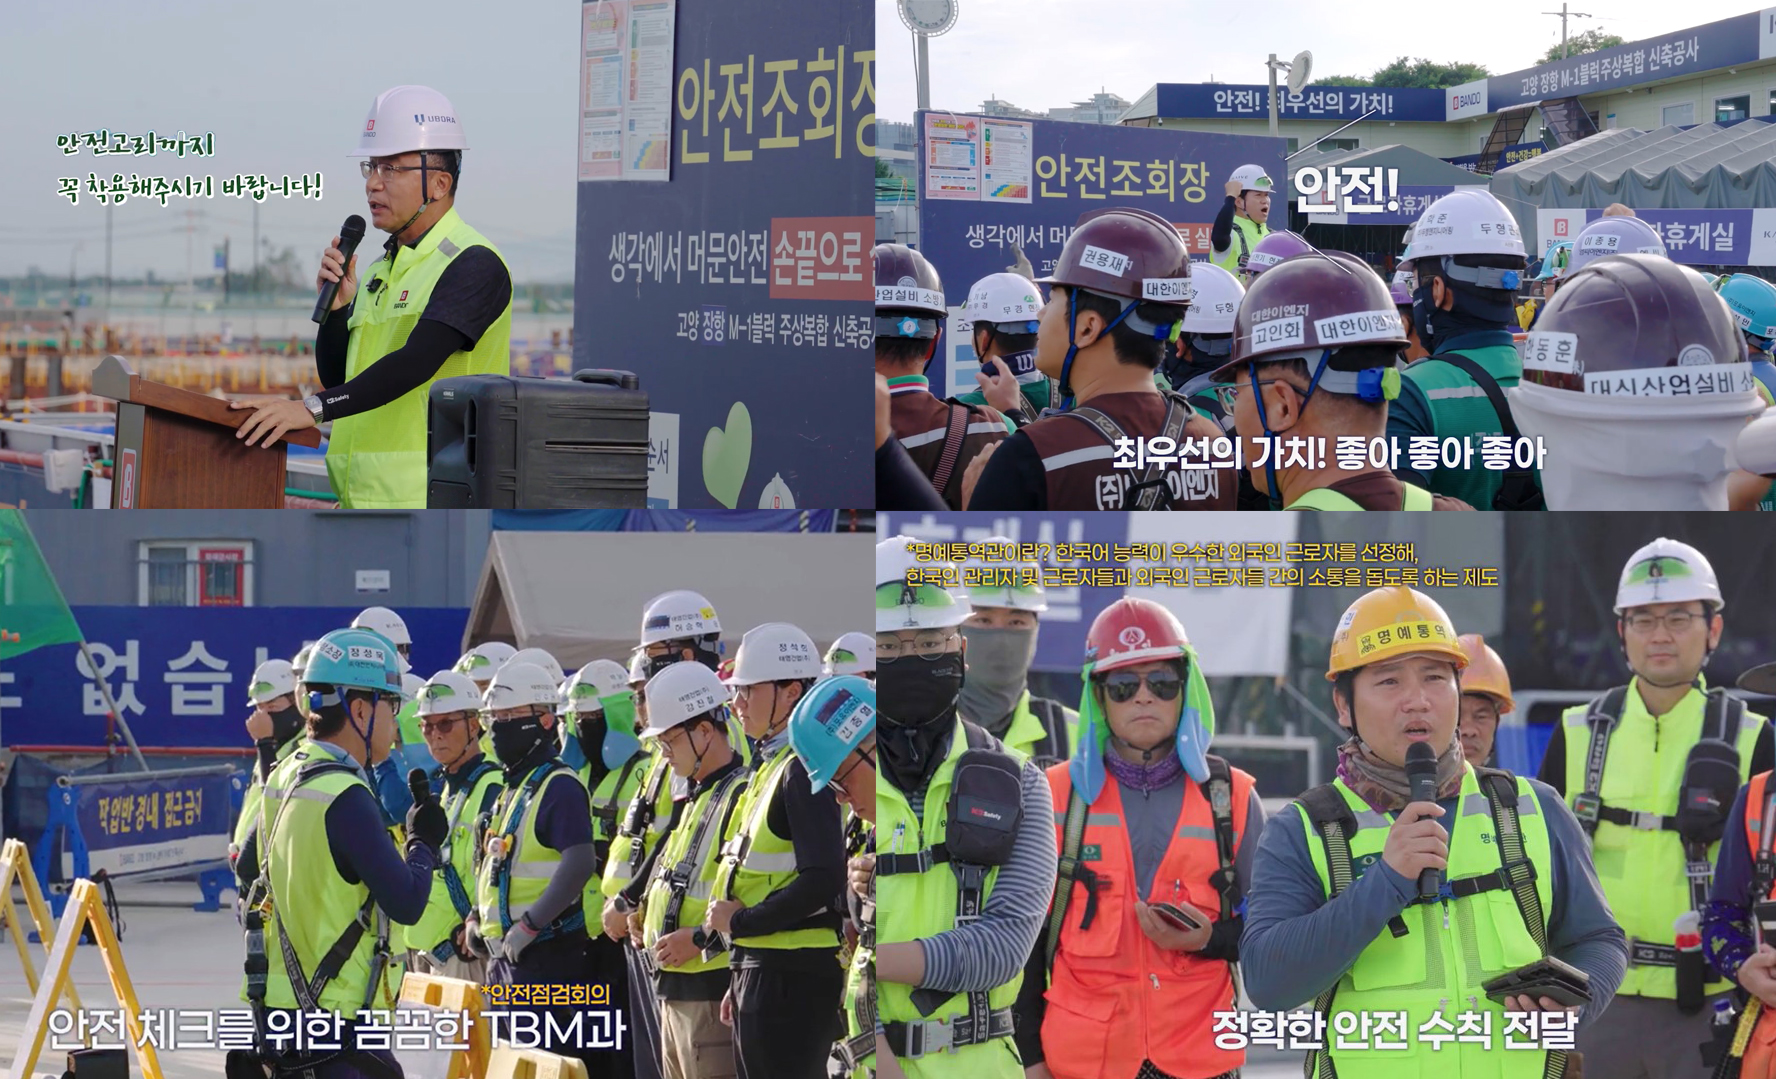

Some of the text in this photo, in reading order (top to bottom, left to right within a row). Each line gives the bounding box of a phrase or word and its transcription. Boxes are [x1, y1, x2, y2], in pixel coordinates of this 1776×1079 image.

[1520, 36, 1699, 96] 고양 장항 M-1블럭 주상복합 신축공사
[1214, 90, 1260, 112] 안전!
[1349, 92, 1393, 115] 가치!
[1460, 91, 1481, 107] BANDO
[427, 115, 456, 124] UBORA
[1035, 153, 1210, 203] 안전조회장
[965, 224, 1045, 249] 생각에서
[608, 230, 682, 284] 생각에서
[773, 230, 863, 287] 손끝으로
[1085, 250, 1124, 271] 권용재
[1252, 304, 1310, 322] 대한이엔지
[676, 310, 875, 349] 고양 장항 M-1블럭 주상복합 신축공
[1255, 322, 1301, 345] 고인화
[75, 639, 268, 716] 없습
